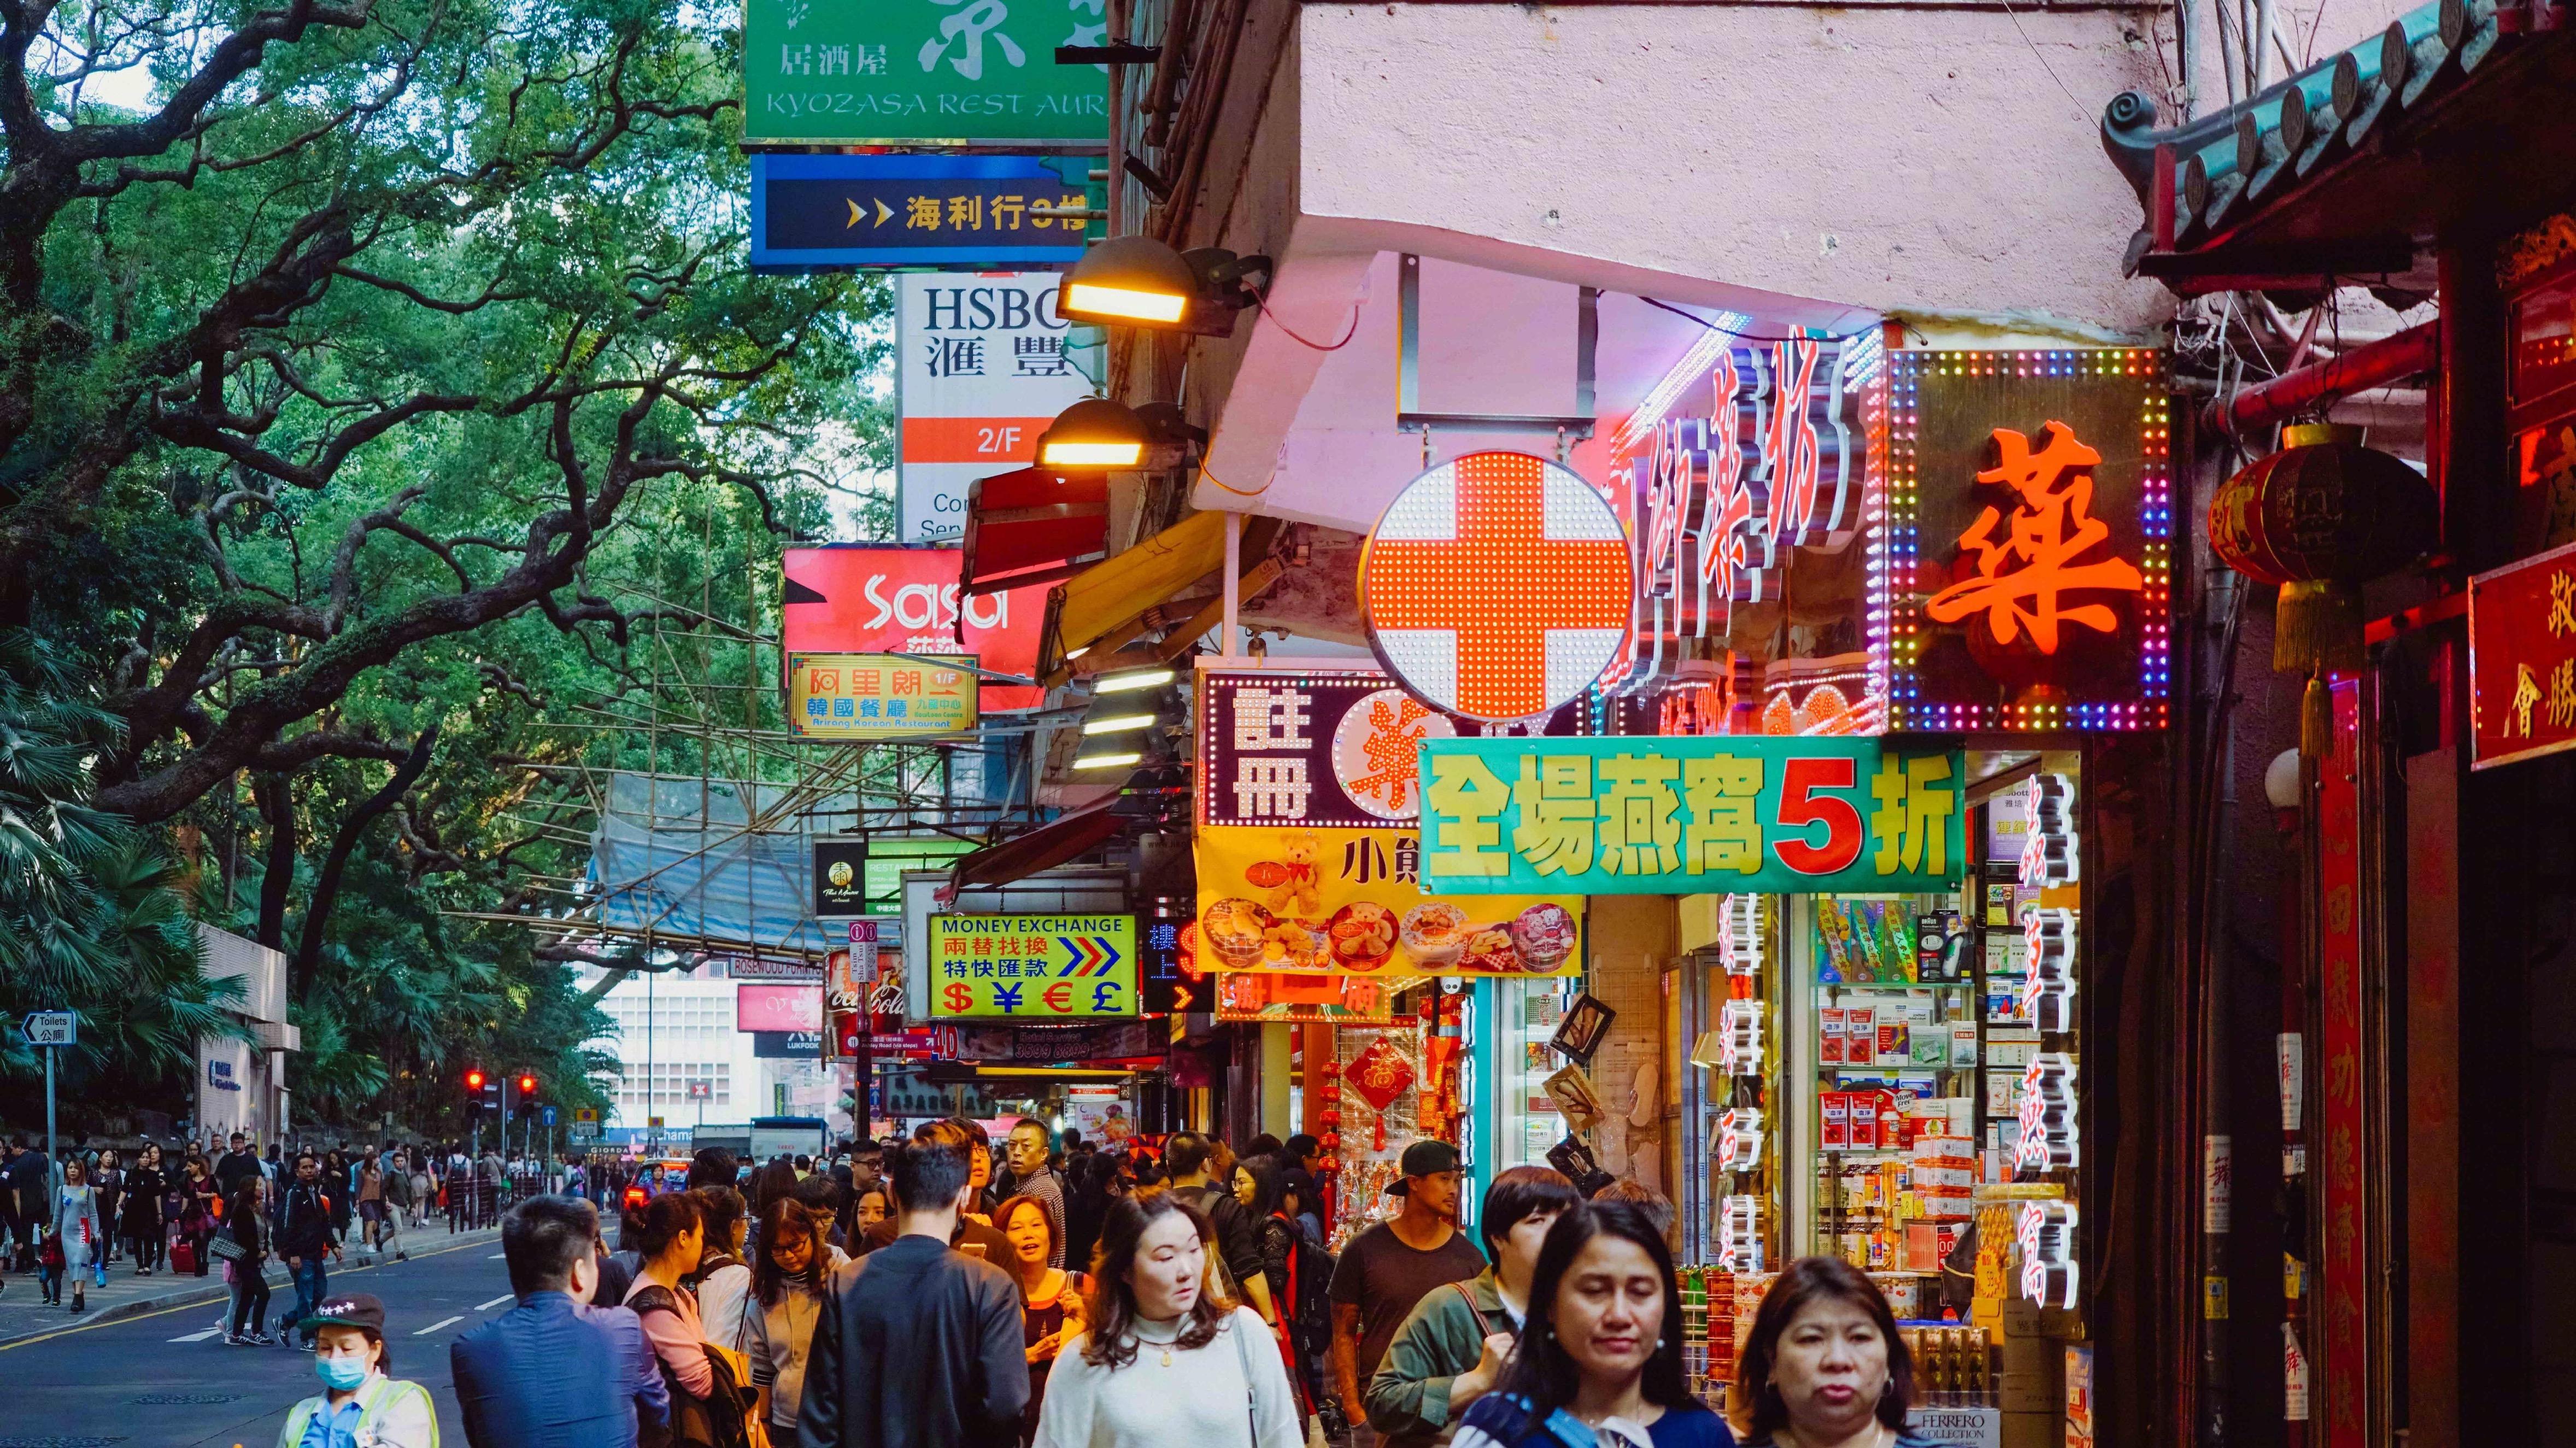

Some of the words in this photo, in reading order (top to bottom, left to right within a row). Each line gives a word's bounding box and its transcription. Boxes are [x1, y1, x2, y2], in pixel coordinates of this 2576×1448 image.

[780, 43, 888, 76] 居酒屋
[767, 93, 927, 118] KYOZASA
[938, 94, 1024, 115] REST
[1037, 94, 1108, 116] AUR
[924, 287, 1070, 329] HSBC
[978, 427, 1021, 453] 2/F
[810, 668, 922, 696] 阿里朗
[935, 673, 957, 684] 1/F
[807, 698, 908, 718] 韓國餐廳
[813, 719, 850, 728] Arirang
[854, 719, 891, 727] Korean
[895, 719, 951, 728] Restaurant
[1426, 752, 1953, 876] 全場燕窩5折
[942, 920, 1012, 933] MONEY
[1018, 919, 1123, 932] EXCHANGE
[943, 936, 1049, 956] 兩替找換
[1149, 923, 1177, 980] 樓上
[735, 960, 783, 974] ROSEWOOD
[867, 943, 876, 981] 尖沙咀
[943, 959, 1049, 979] 特快匯款
[942, 981, 974, 1014] $
[991, 981, 1024, 1014] ¥
[1042, 981, 1073, 1013] €
[1091, 981, 1123, 1013] £
[40, 1017, 68, 1026] Toilets
[40, 1030, 64, 1042] 公廁
[1896, 1092, 1913, 1102] Move
[1898, 1099, 1911, 1108] Free
[1921, 1414, 1985, 1428] FERRERO
[1921, 1429, 1984, 1439] COLLECTION
